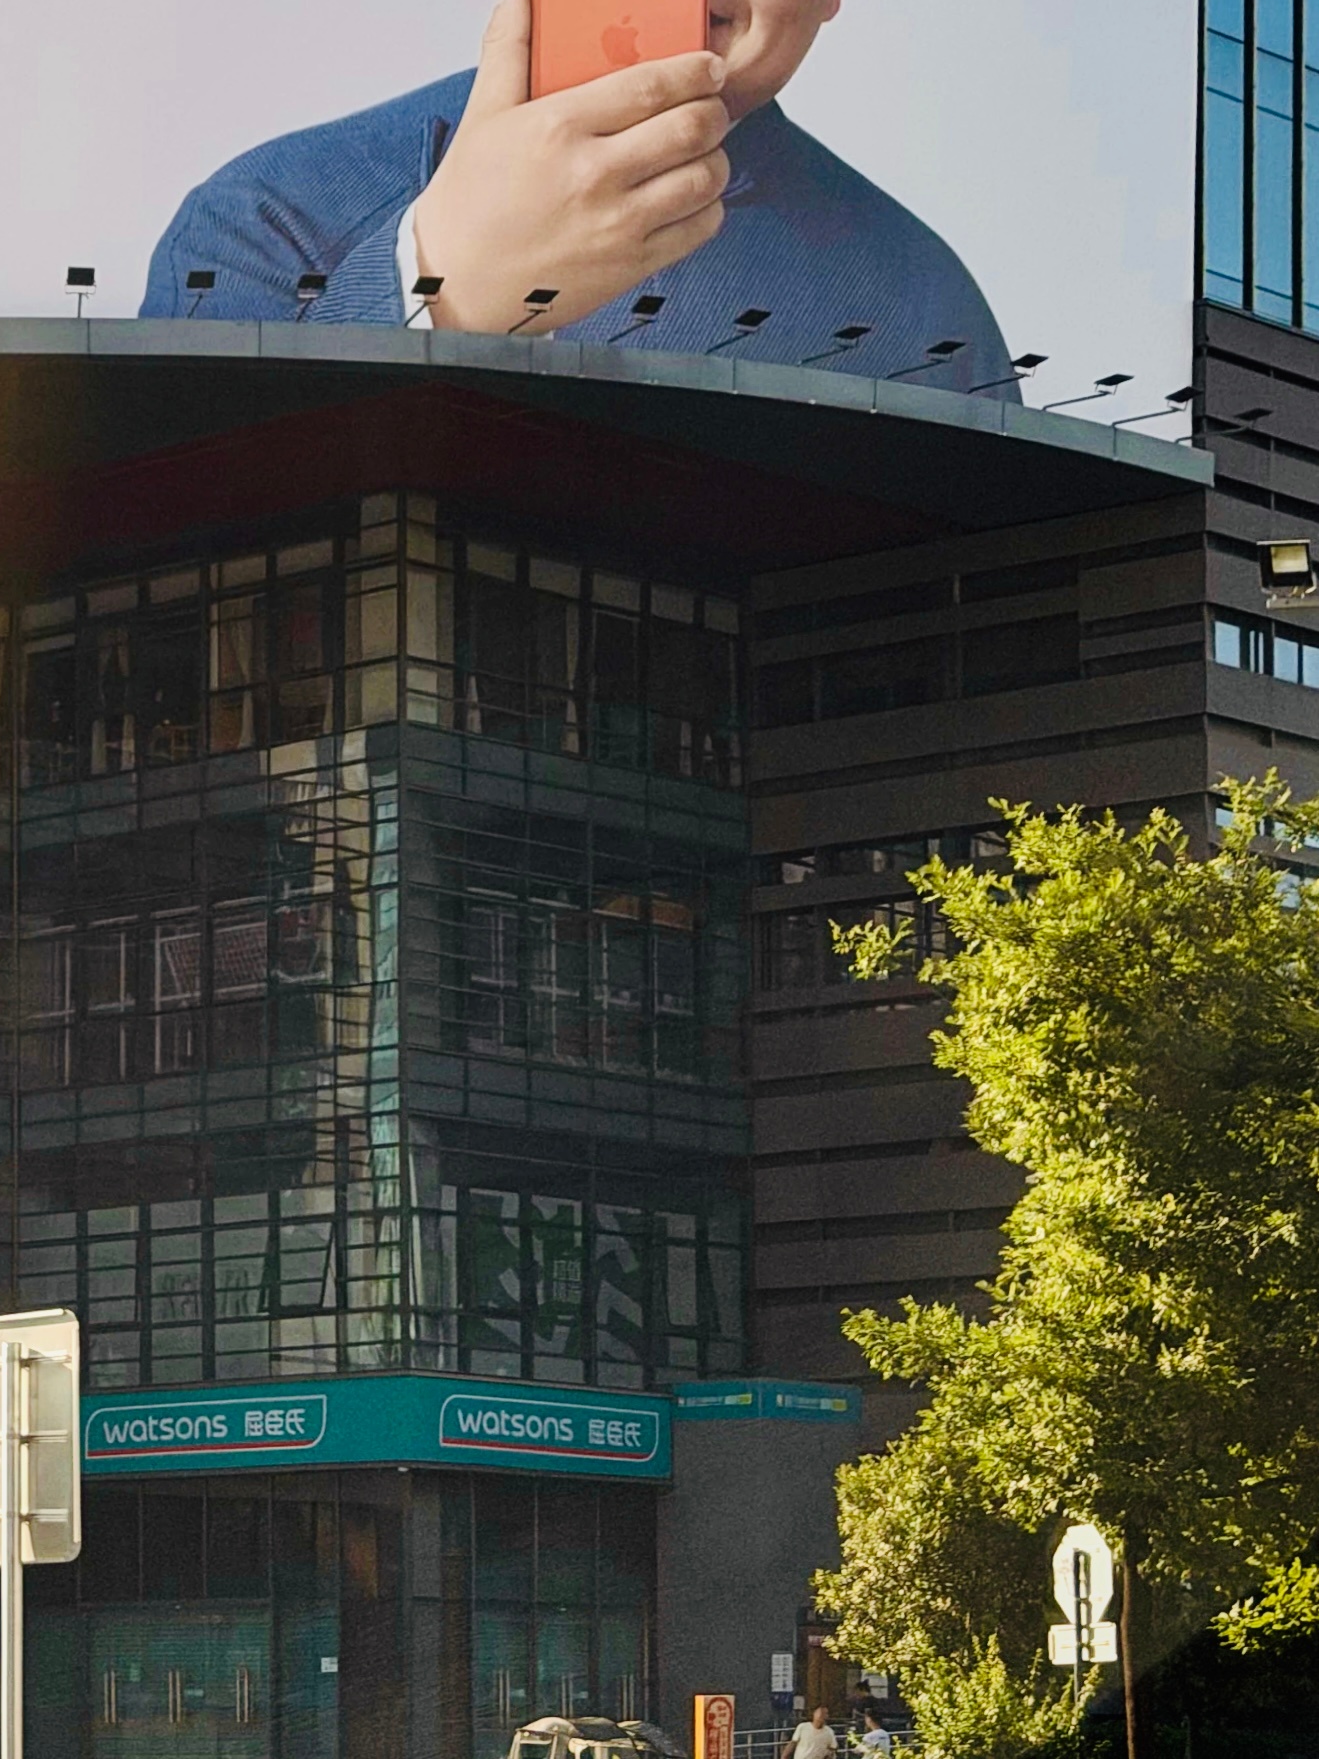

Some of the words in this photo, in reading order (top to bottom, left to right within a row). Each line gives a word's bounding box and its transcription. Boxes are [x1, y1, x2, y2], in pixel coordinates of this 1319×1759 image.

[104, 1415, 228, 1444] watsons
[244, 1408, 305, 1437] 屈臣氏
[458, 1409, 573, 1442] watsons
